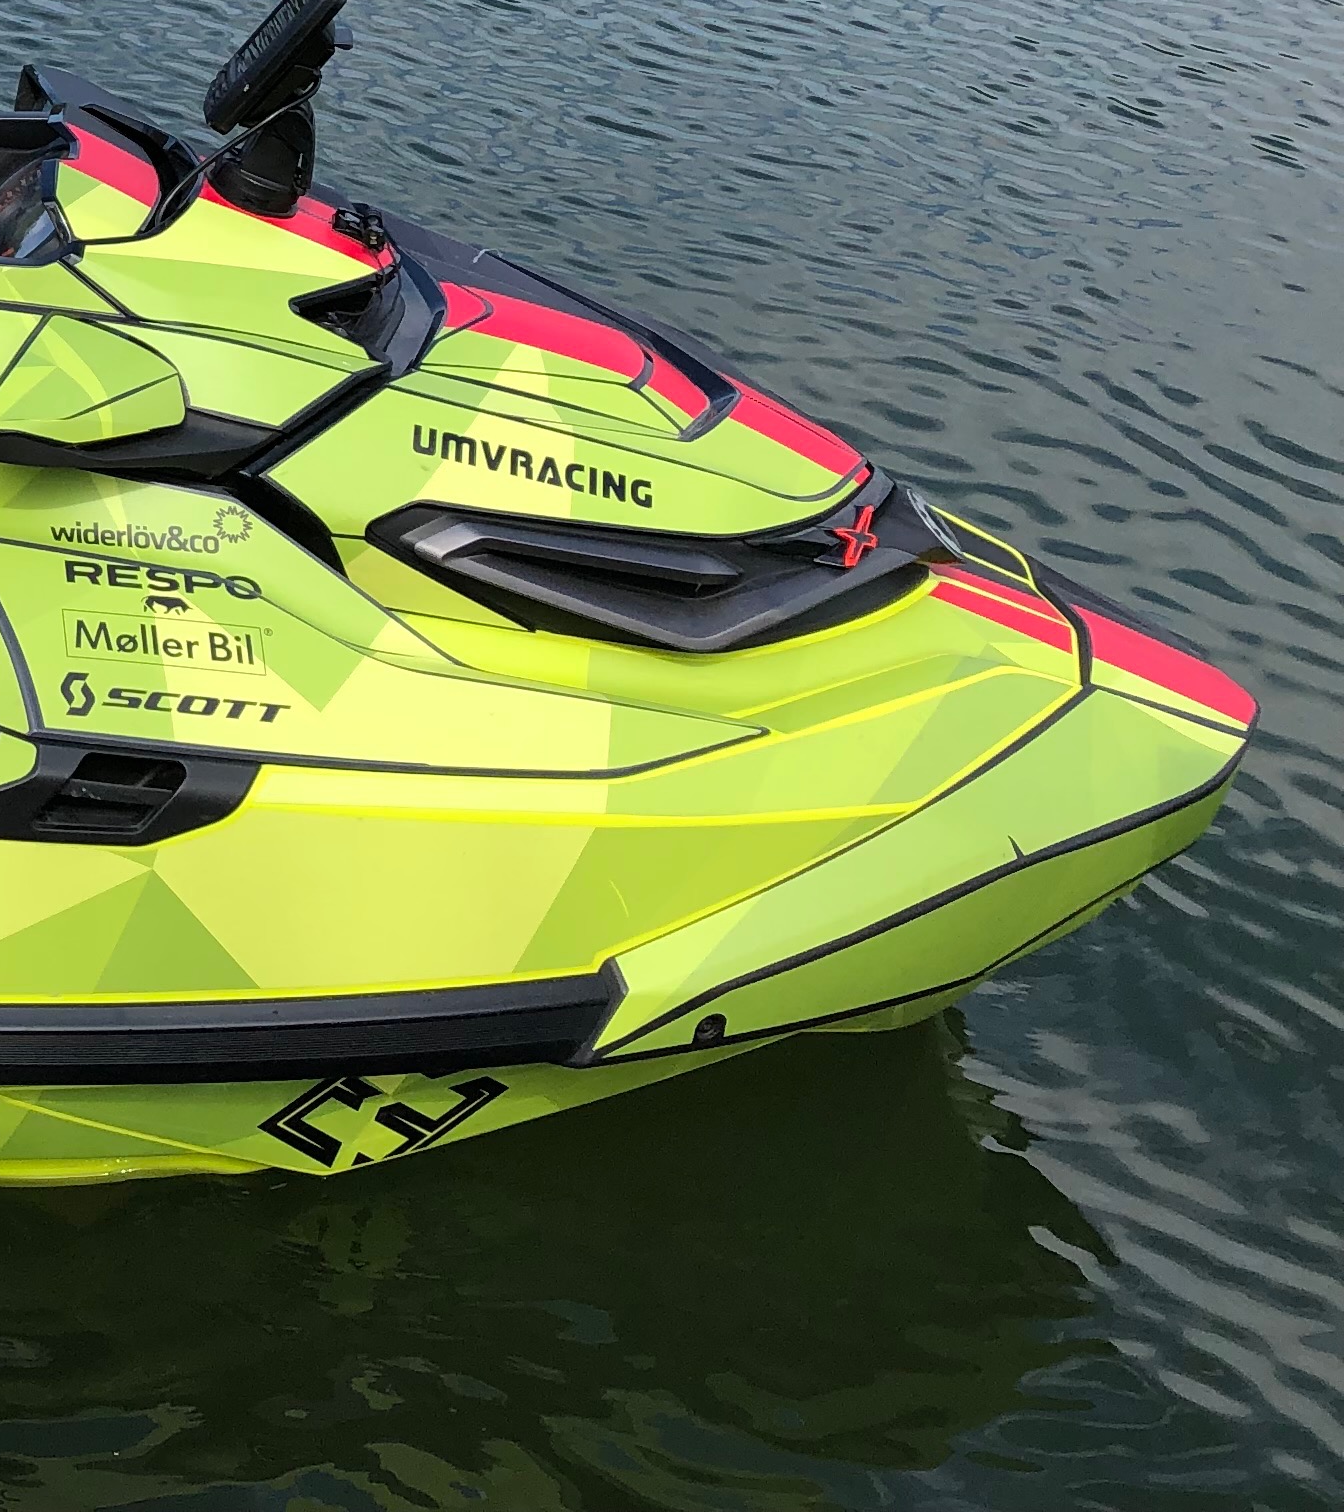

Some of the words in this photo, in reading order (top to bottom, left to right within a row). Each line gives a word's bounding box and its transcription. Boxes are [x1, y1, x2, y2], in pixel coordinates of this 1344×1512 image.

[51, 521, 220, 554] widerlöv&co
[64, 560, 262, 600] RESPO
[75, 619, 199, 659] Møller
[208, 631, 254, 665] Bil
[101, 687, 292, 723] SCOTT
